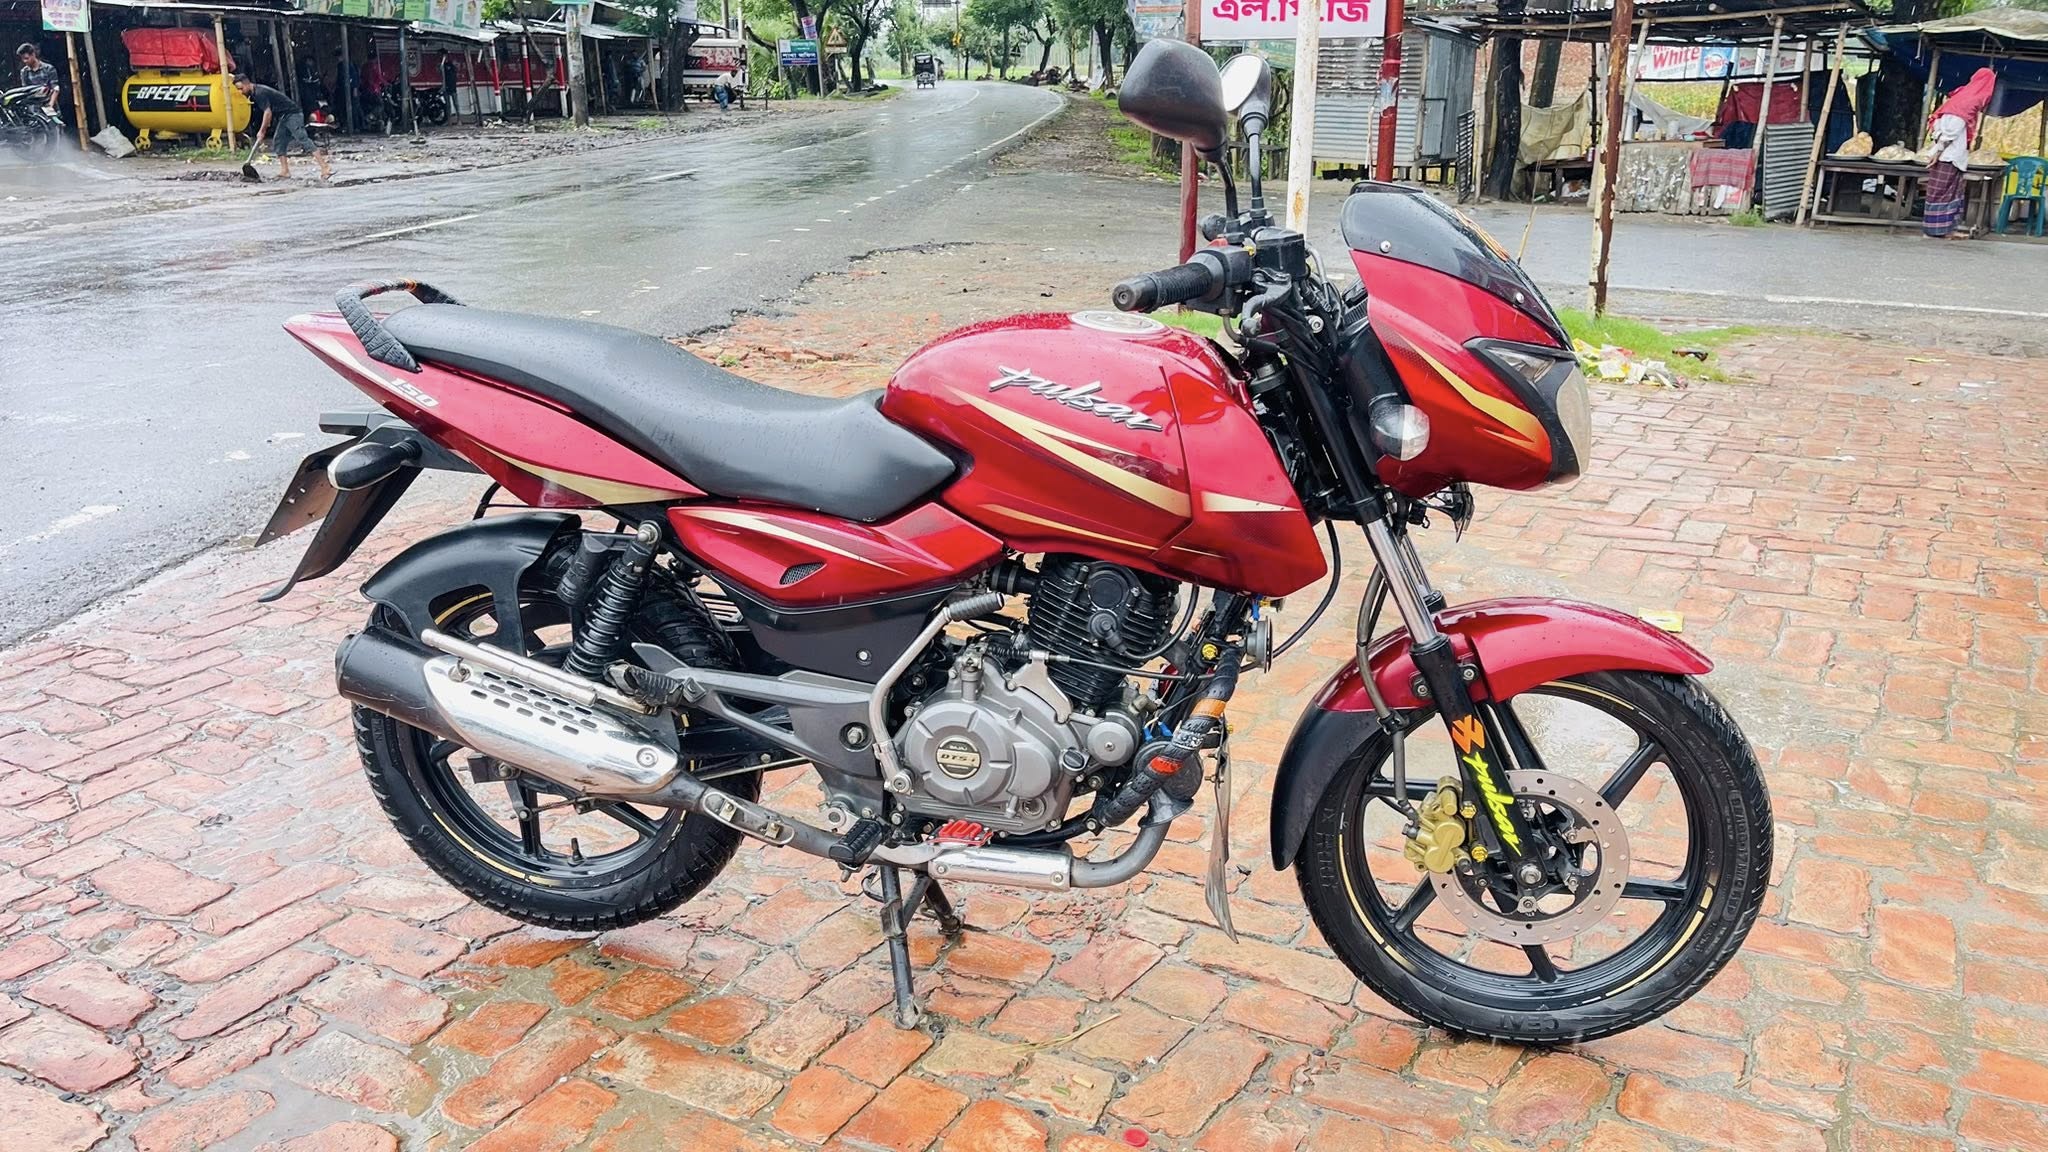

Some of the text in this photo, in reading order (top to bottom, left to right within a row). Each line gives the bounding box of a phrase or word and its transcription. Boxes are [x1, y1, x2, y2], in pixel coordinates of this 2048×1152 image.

[1653, 46, 1700, 69] White
[391, 378, 440, 407] 150
[1497, 1013, 1560, 1034] CEAT
